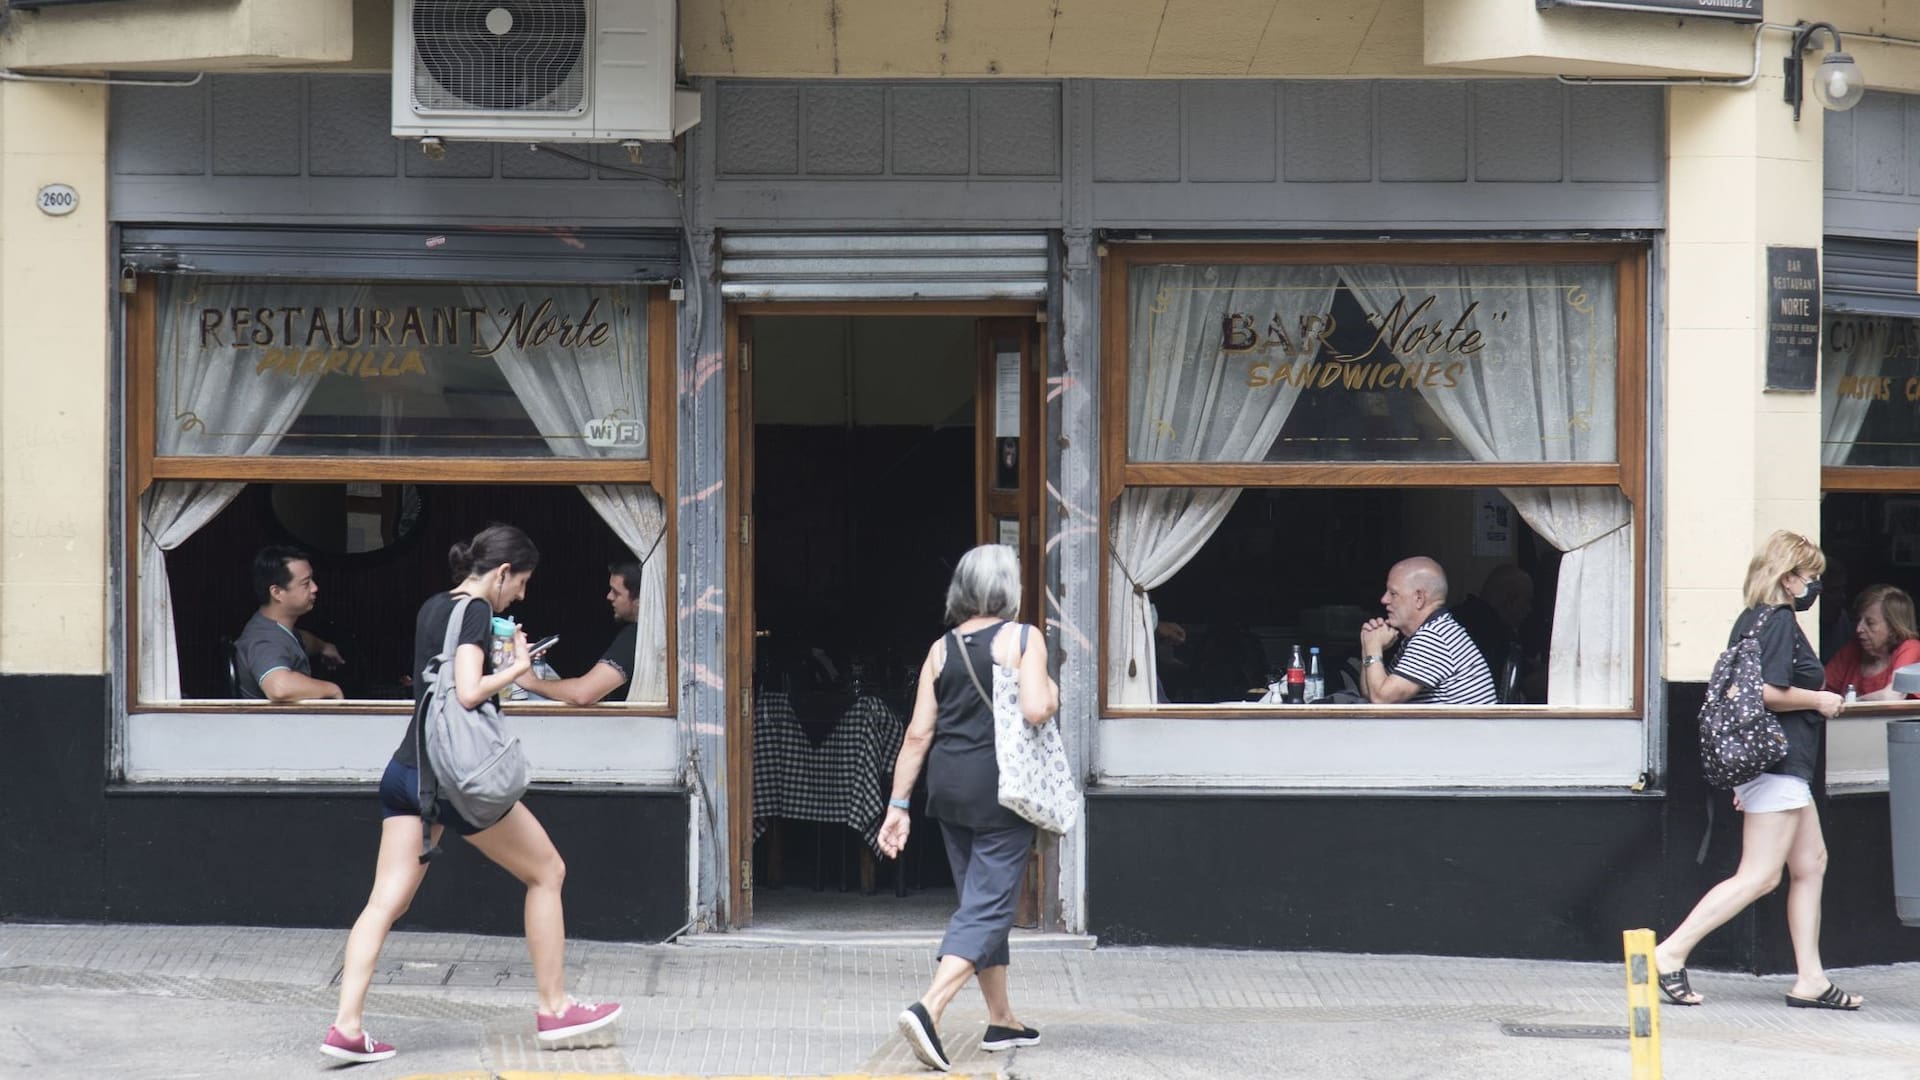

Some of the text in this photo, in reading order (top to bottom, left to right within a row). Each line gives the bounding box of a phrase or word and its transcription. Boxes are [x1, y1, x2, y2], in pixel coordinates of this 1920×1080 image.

[1745, 0, 1752, 9] 2
[43, 192, 72, 206] 2600
[1787, 259, 1801, 272] BAR
[1773, 276, 1816, 290] RESTAURANT
[1780, 298, 1810, 316] NORTE
[200, 305, 493, 350] RESTAURANT
[1220, 311, 1340, 355] BAR
[256, 349, 427, 378] PARRILLA
[1246, 360, 1466, 391] SANDWICHES
